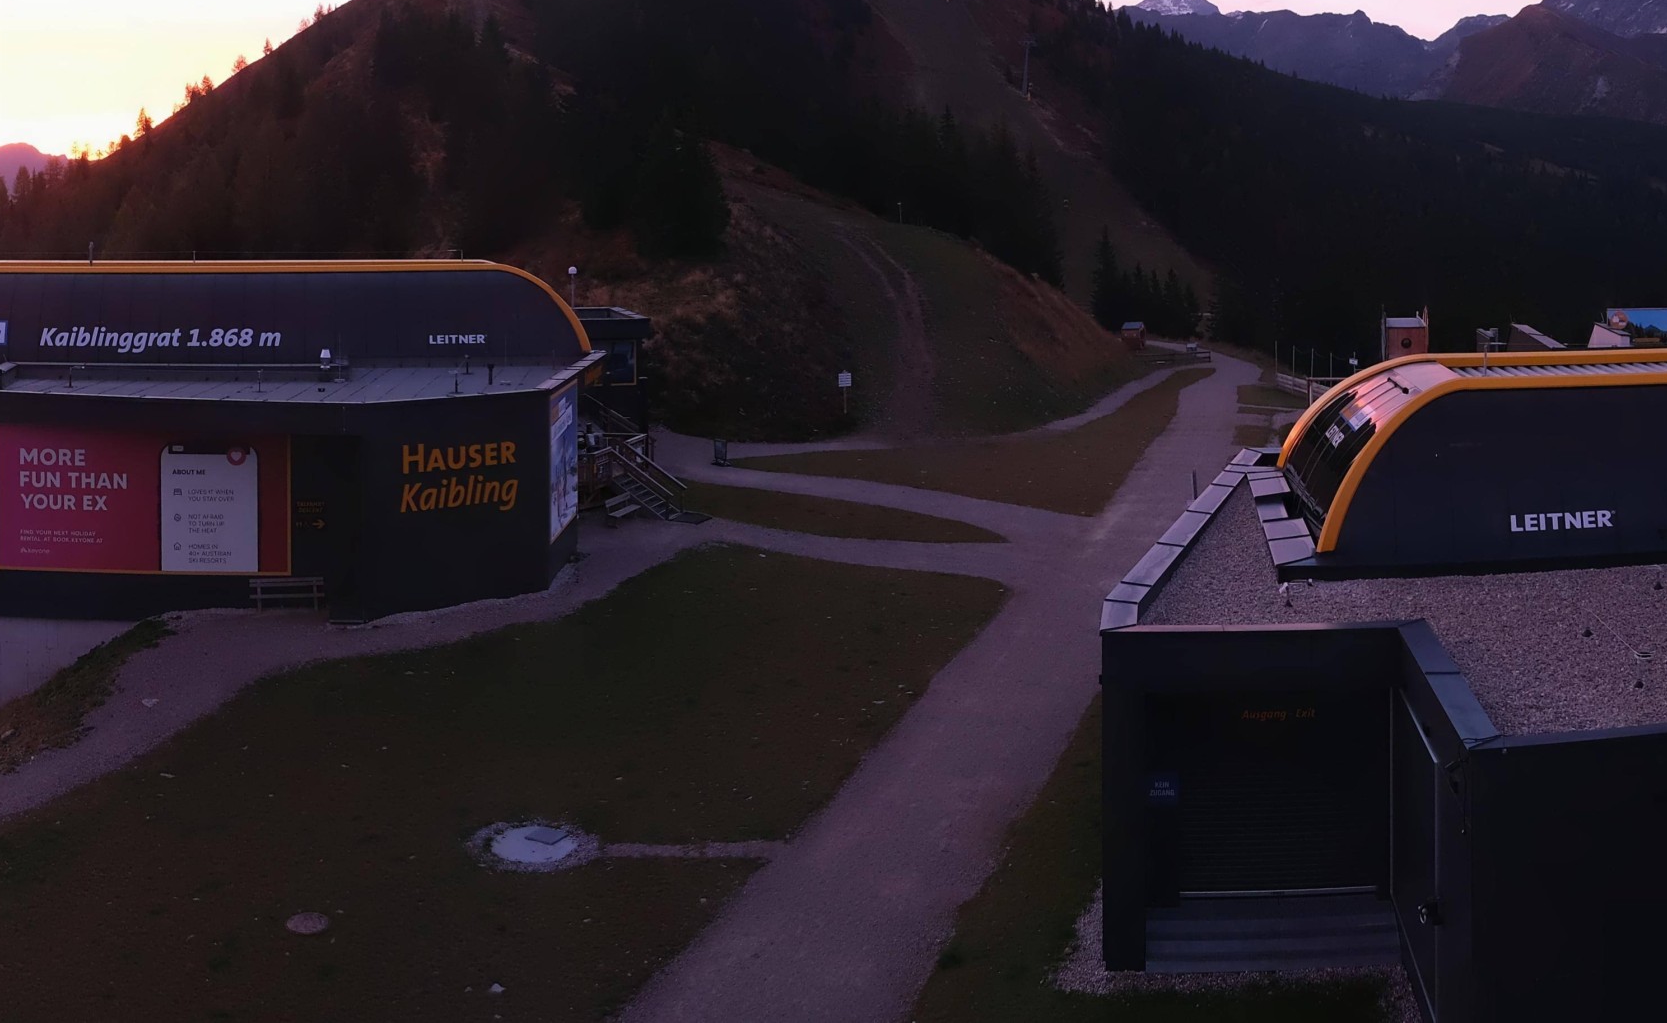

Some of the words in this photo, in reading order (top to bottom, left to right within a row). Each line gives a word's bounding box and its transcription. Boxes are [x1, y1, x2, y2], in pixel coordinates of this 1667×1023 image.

[39, 326, 182, 353] Kaiblinggrat
[186, 327, 254, 347] 1.868
[258, 331, 282, 347] m
[428, 333, 487, 345] LEITNER
[19, 447, 86, 467] MORE
[402, 440, 517, 475] HAUSER
[19, 471, 61, 488] FUN
[68, 472, 128, 490] THAN
[20, 493, 77, 511] YOUR
[82, 495, 108, 511] EX
[400, 474, 519, 513] Kaibling
[1509, 509, 1614, 532] LEITNER
[1241, 708, 1288, 722] Ausgang
[1296, 706, 1316, 719] Exit
